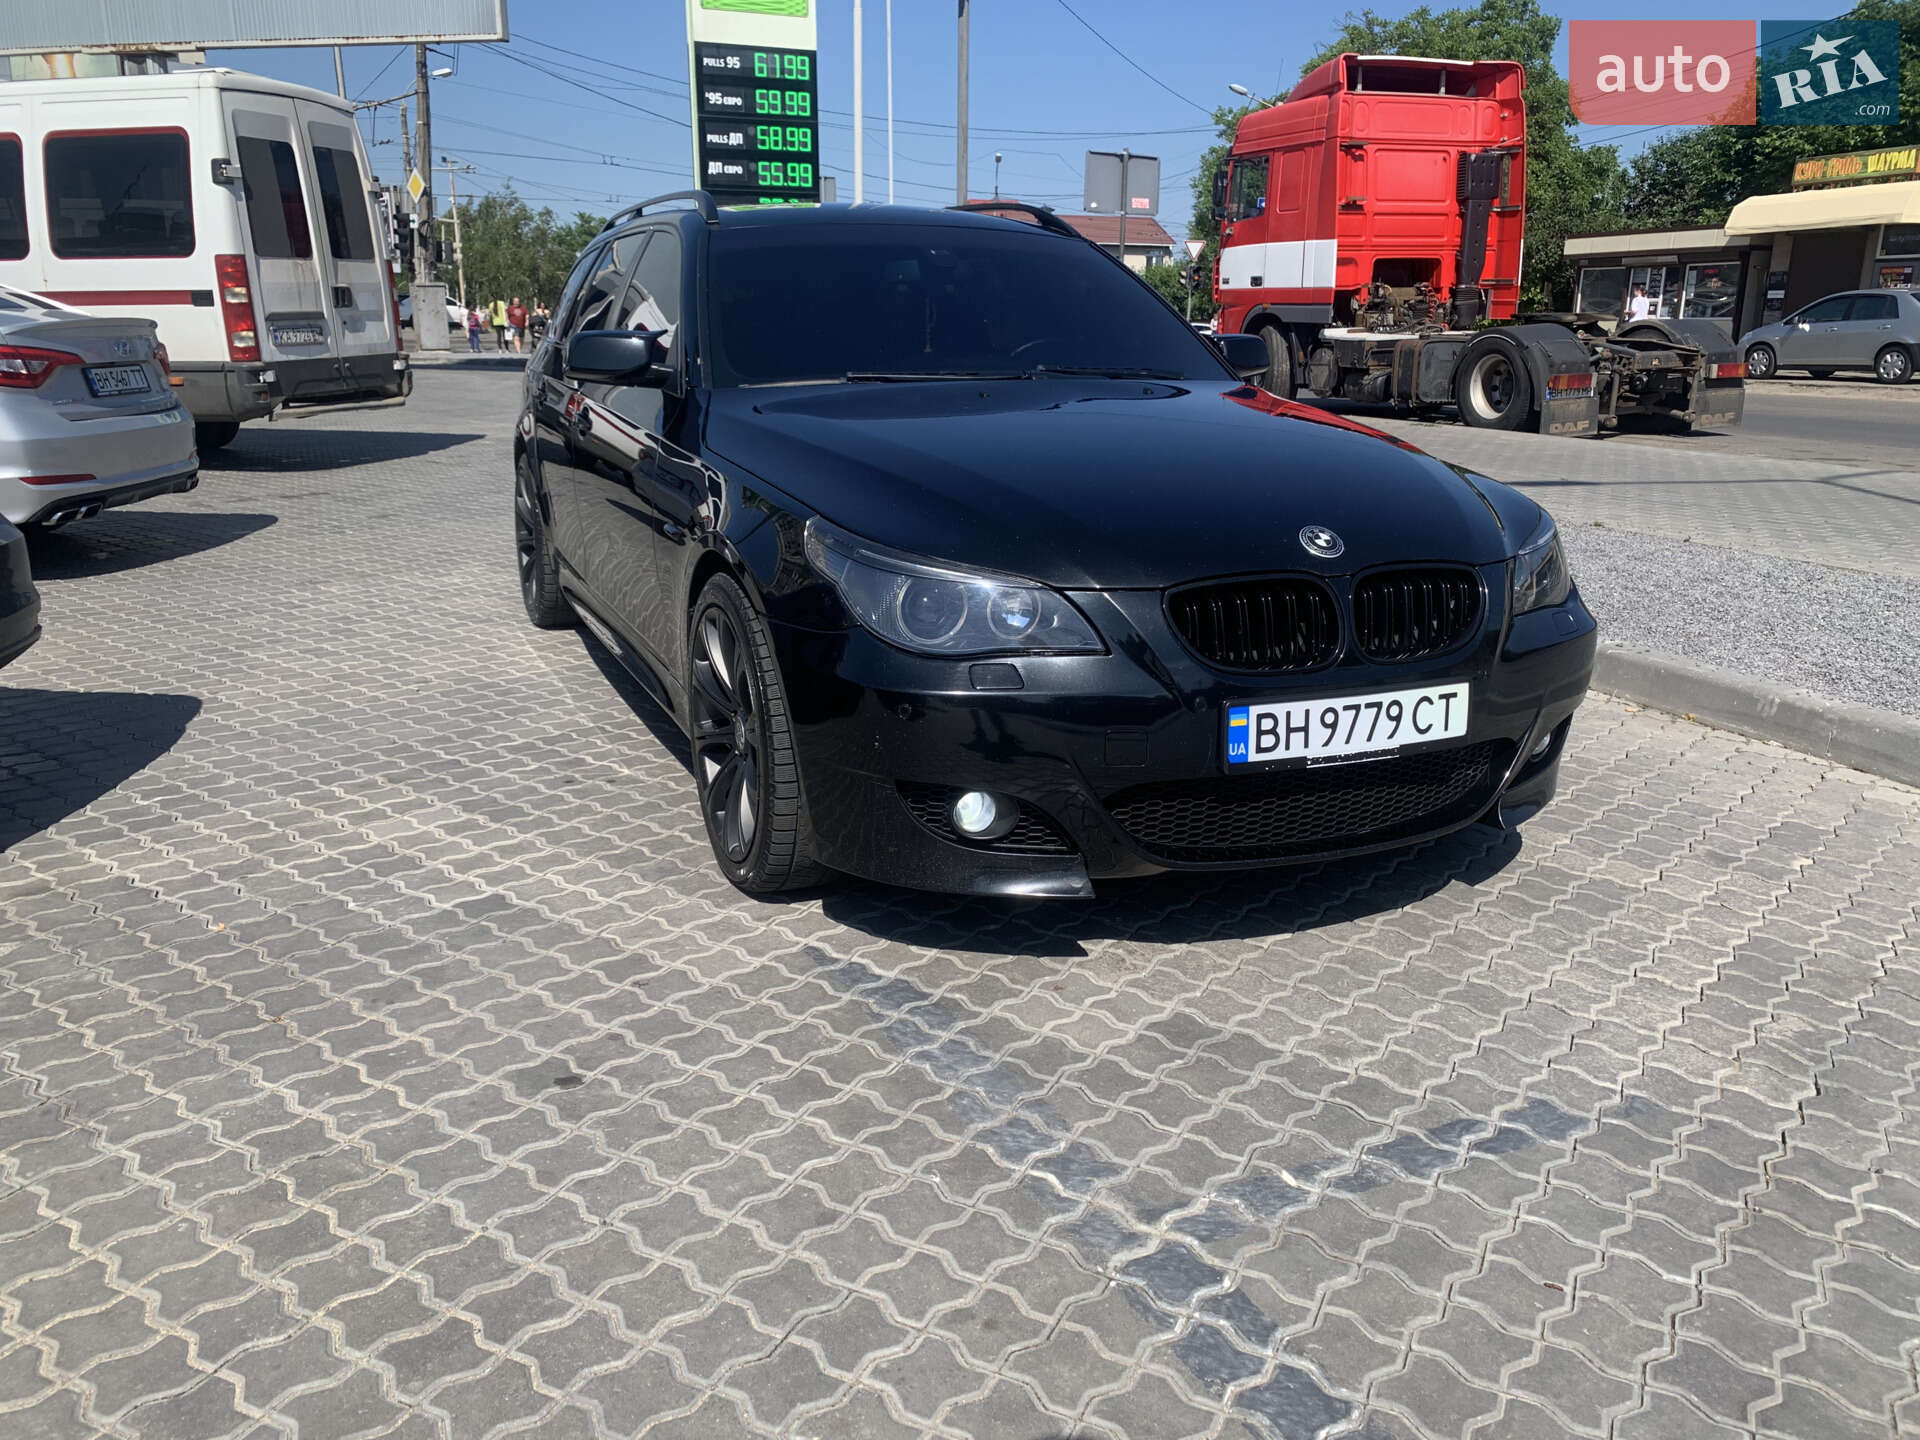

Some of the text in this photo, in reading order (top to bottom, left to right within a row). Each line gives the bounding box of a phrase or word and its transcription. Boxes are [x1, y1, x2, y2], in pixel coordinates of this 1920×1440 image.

[703, 56, 741, 69] PULLS 95
[707, 132, 743, 146] PULLS ДП
[756, 125, 812, 152] 58.99
[708, 161, 723, 175] ДП
[1867, 149, 1917, 173] ШАУРМА
[758, 161, 813, 188] 55.99
[1550, 420, 1590, 433] DAF
[1255, 692, 1458, 754] BH 9779 CT
[1229, 743, 1246, 756] UA
